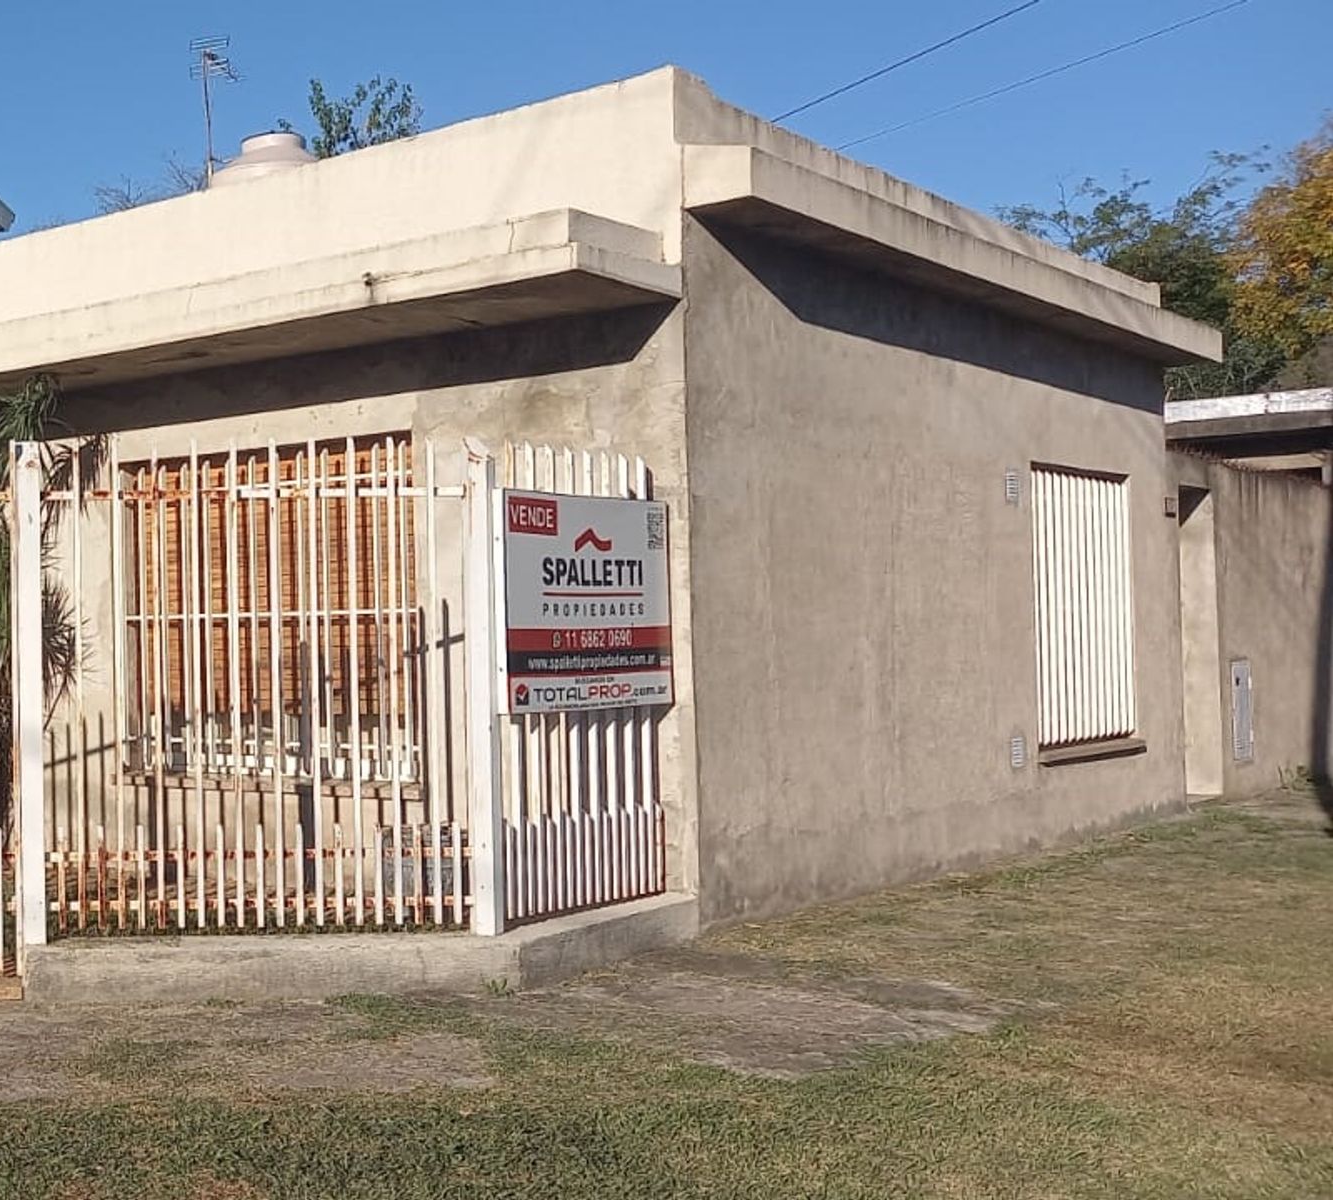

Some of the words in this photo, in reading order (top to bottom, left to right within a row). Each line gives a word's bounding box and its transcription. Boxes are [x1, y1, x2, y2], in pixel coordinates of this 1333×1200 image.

[509, 504, 554, 528] VENDE
[542, 556, 643, 586] SPALLETTI
[543, 602, 644, 617] PROPIEDADES
[565, 631, 577, 648] 11
